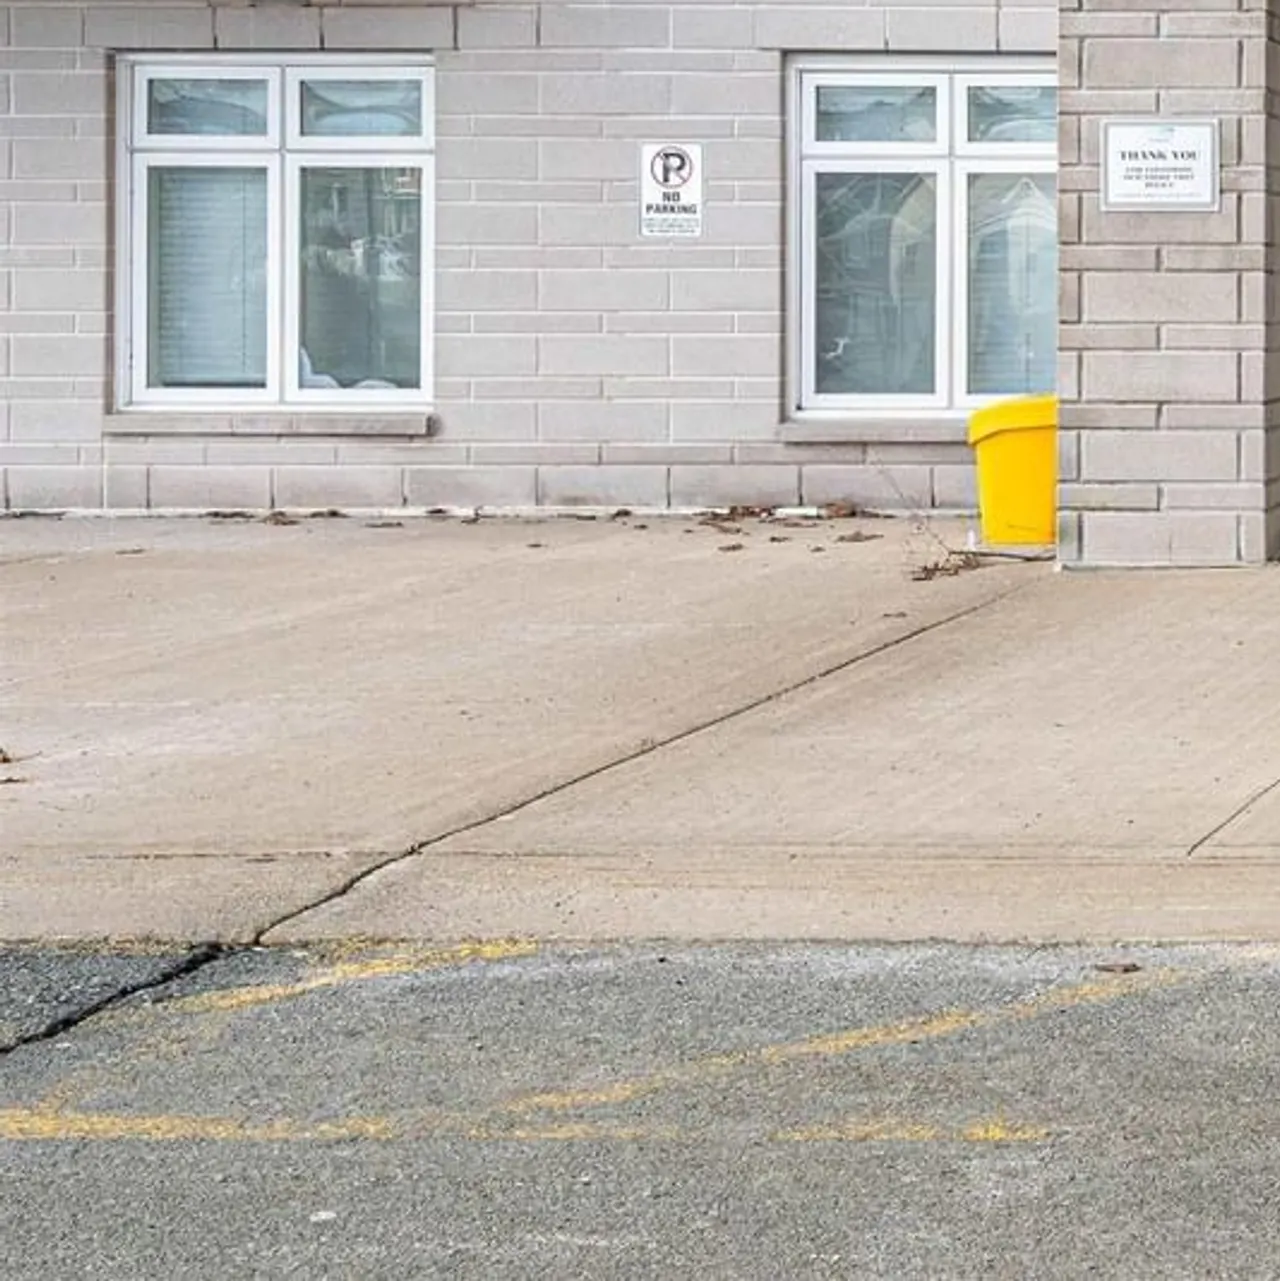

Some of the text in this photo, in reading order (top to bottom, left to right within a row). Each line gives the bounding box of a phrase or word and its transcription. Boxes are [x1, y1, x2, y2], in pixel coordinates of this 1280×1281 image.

[1120, 150, 1201, 161] THANK YOU
[662, 191, 681, 202] NO
[645, 203, 697, 214] PARKING
